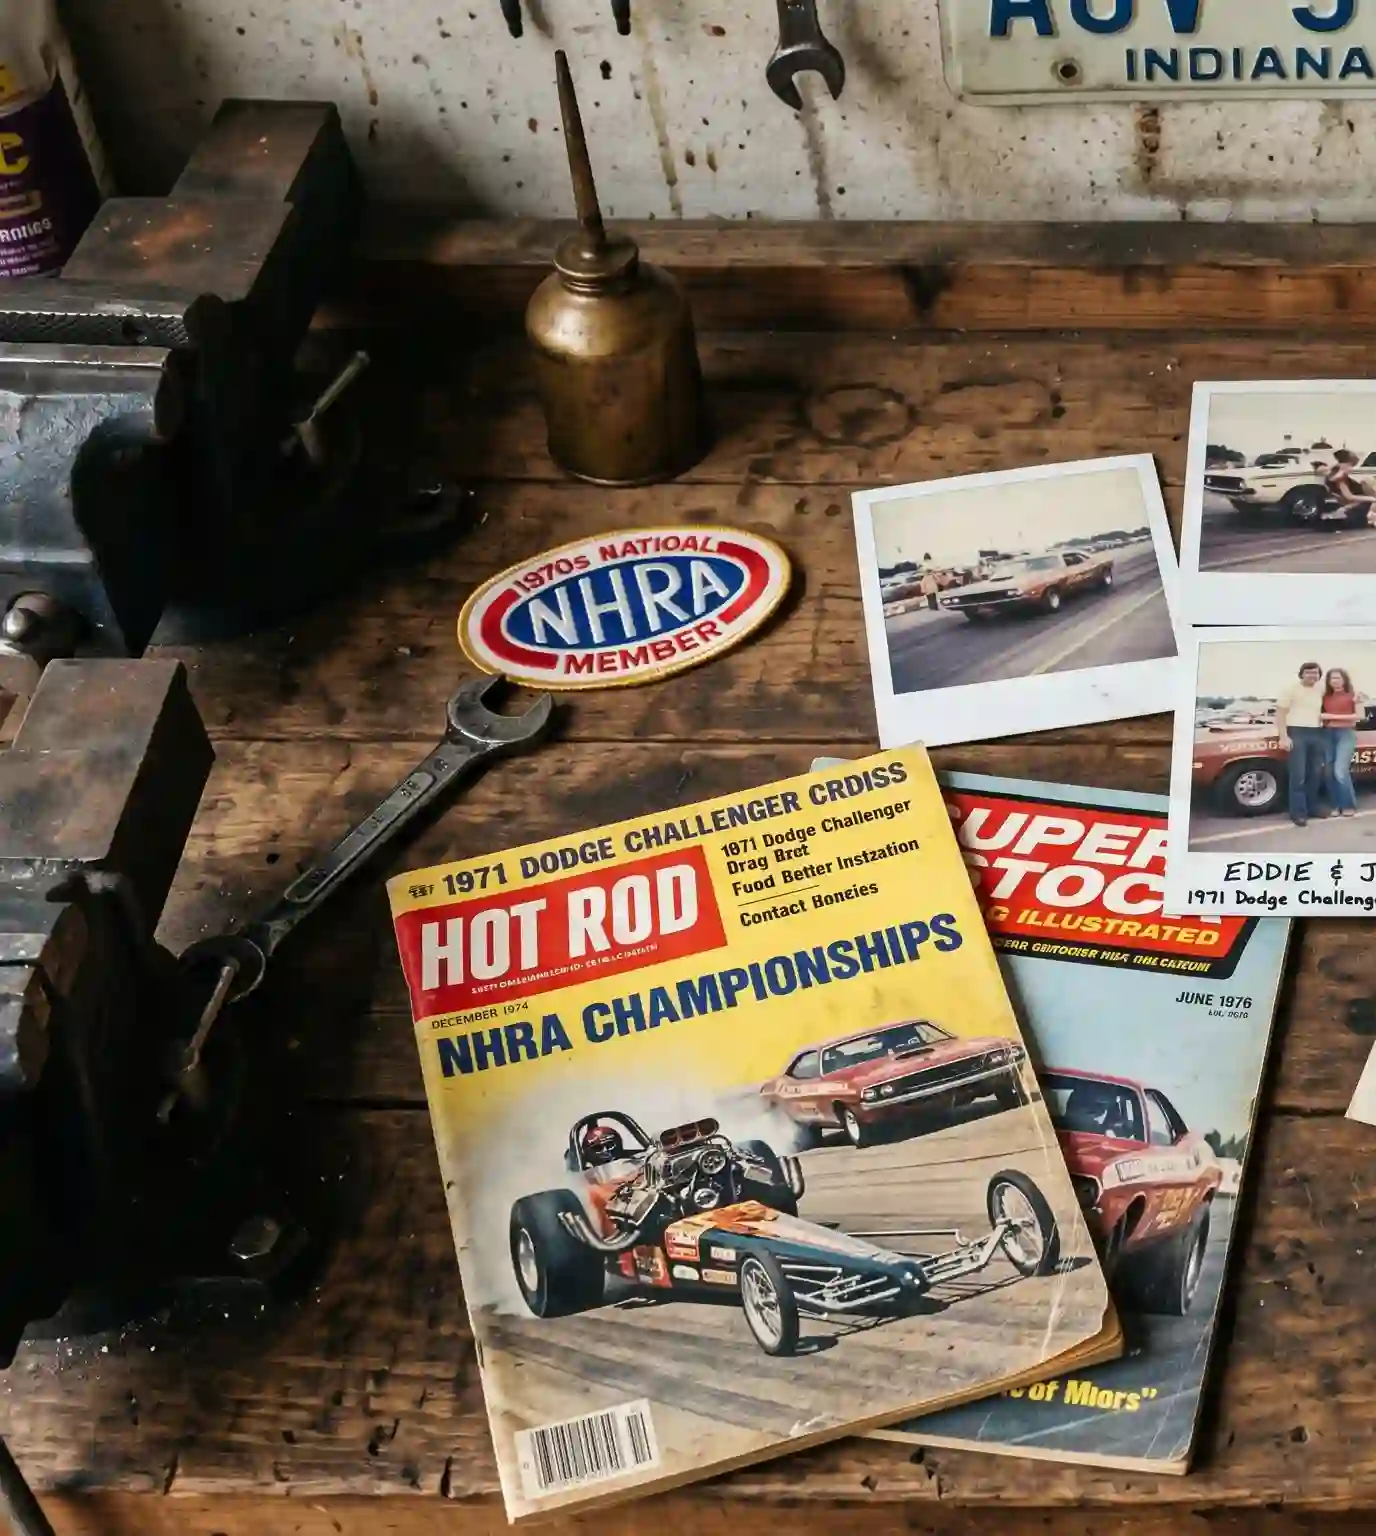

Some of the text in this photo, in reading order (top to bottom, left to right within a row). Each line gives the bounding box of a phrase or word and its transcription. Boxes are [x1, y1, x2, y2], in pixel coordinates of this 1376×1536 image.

[1125, 47, 1376, 81] INDIANA
[598, 535, 720, 563] NATIOAL
[528, 559, 730, 646] NHRA
[563, 620, 723, 675] MEMBER
[762, 826, 817, 848] Dodge
[821, 800, 912, 833] Challenger
[441, 862, 508, 896] 1971
[519, 837, 617, 880] DODGE
[624, 791, 803, 853] CHALLENGER
[726, 856, 769, 875] Drag
[781, 861, 833, 884] Better
[1224, 861, 1314, 882] EDDIE
[739, 899, 807, 927] Contact
[1188, 890, 1225, 905] 1971
[1235, 889, 1288, 910] Dodge
[420, 898, 547, 991] HOT
[567, 864, 700, 960] ROD
[1016, 908, 1220, 946] ILLUSTRATED
[437, 1013, 574, 1078] NHRA
[582, 912, 964, 1044] CHAMPIONSHIPS
[1175, 991, 1215, 1006] JUNE
[431, 1002, 530, 1030] DECEMBER 1974
